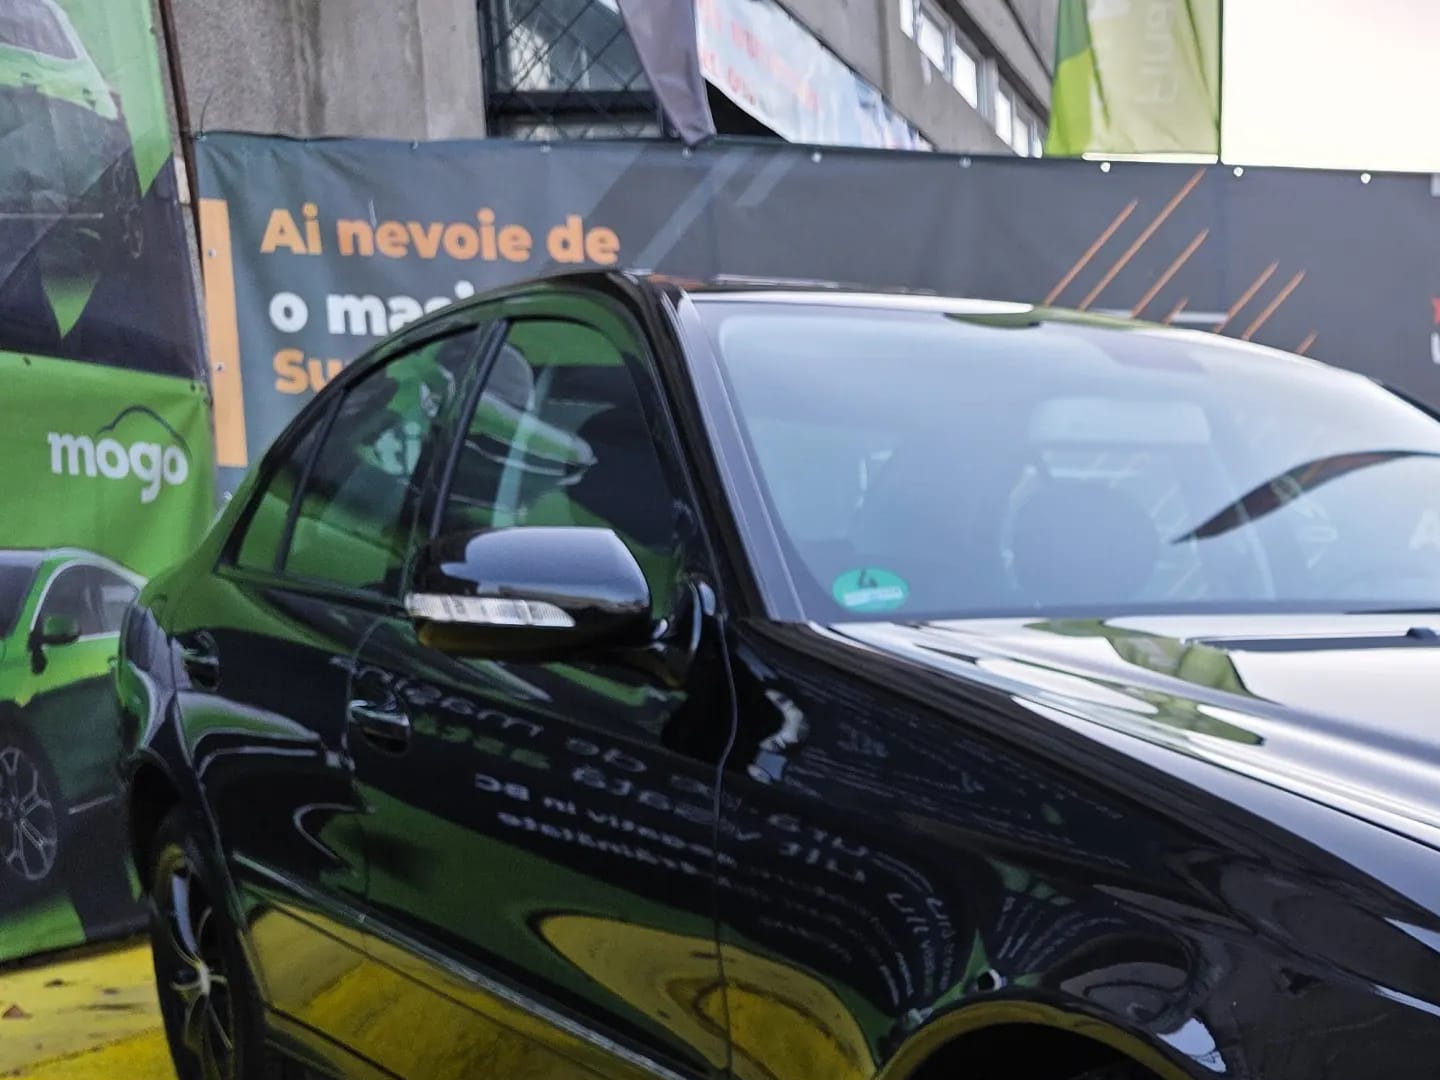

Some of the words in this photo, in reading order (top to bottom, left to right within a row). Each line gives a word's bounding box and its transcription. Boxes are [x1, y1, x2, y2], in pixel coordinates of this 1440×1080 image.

[260, 201, 323, 255] Ai
[336, 207, 533, 263] nevoie
[547, 213, 621, 265] de
[268, 290, 309, 334] o
[47, 431, 189, 505] mogo
